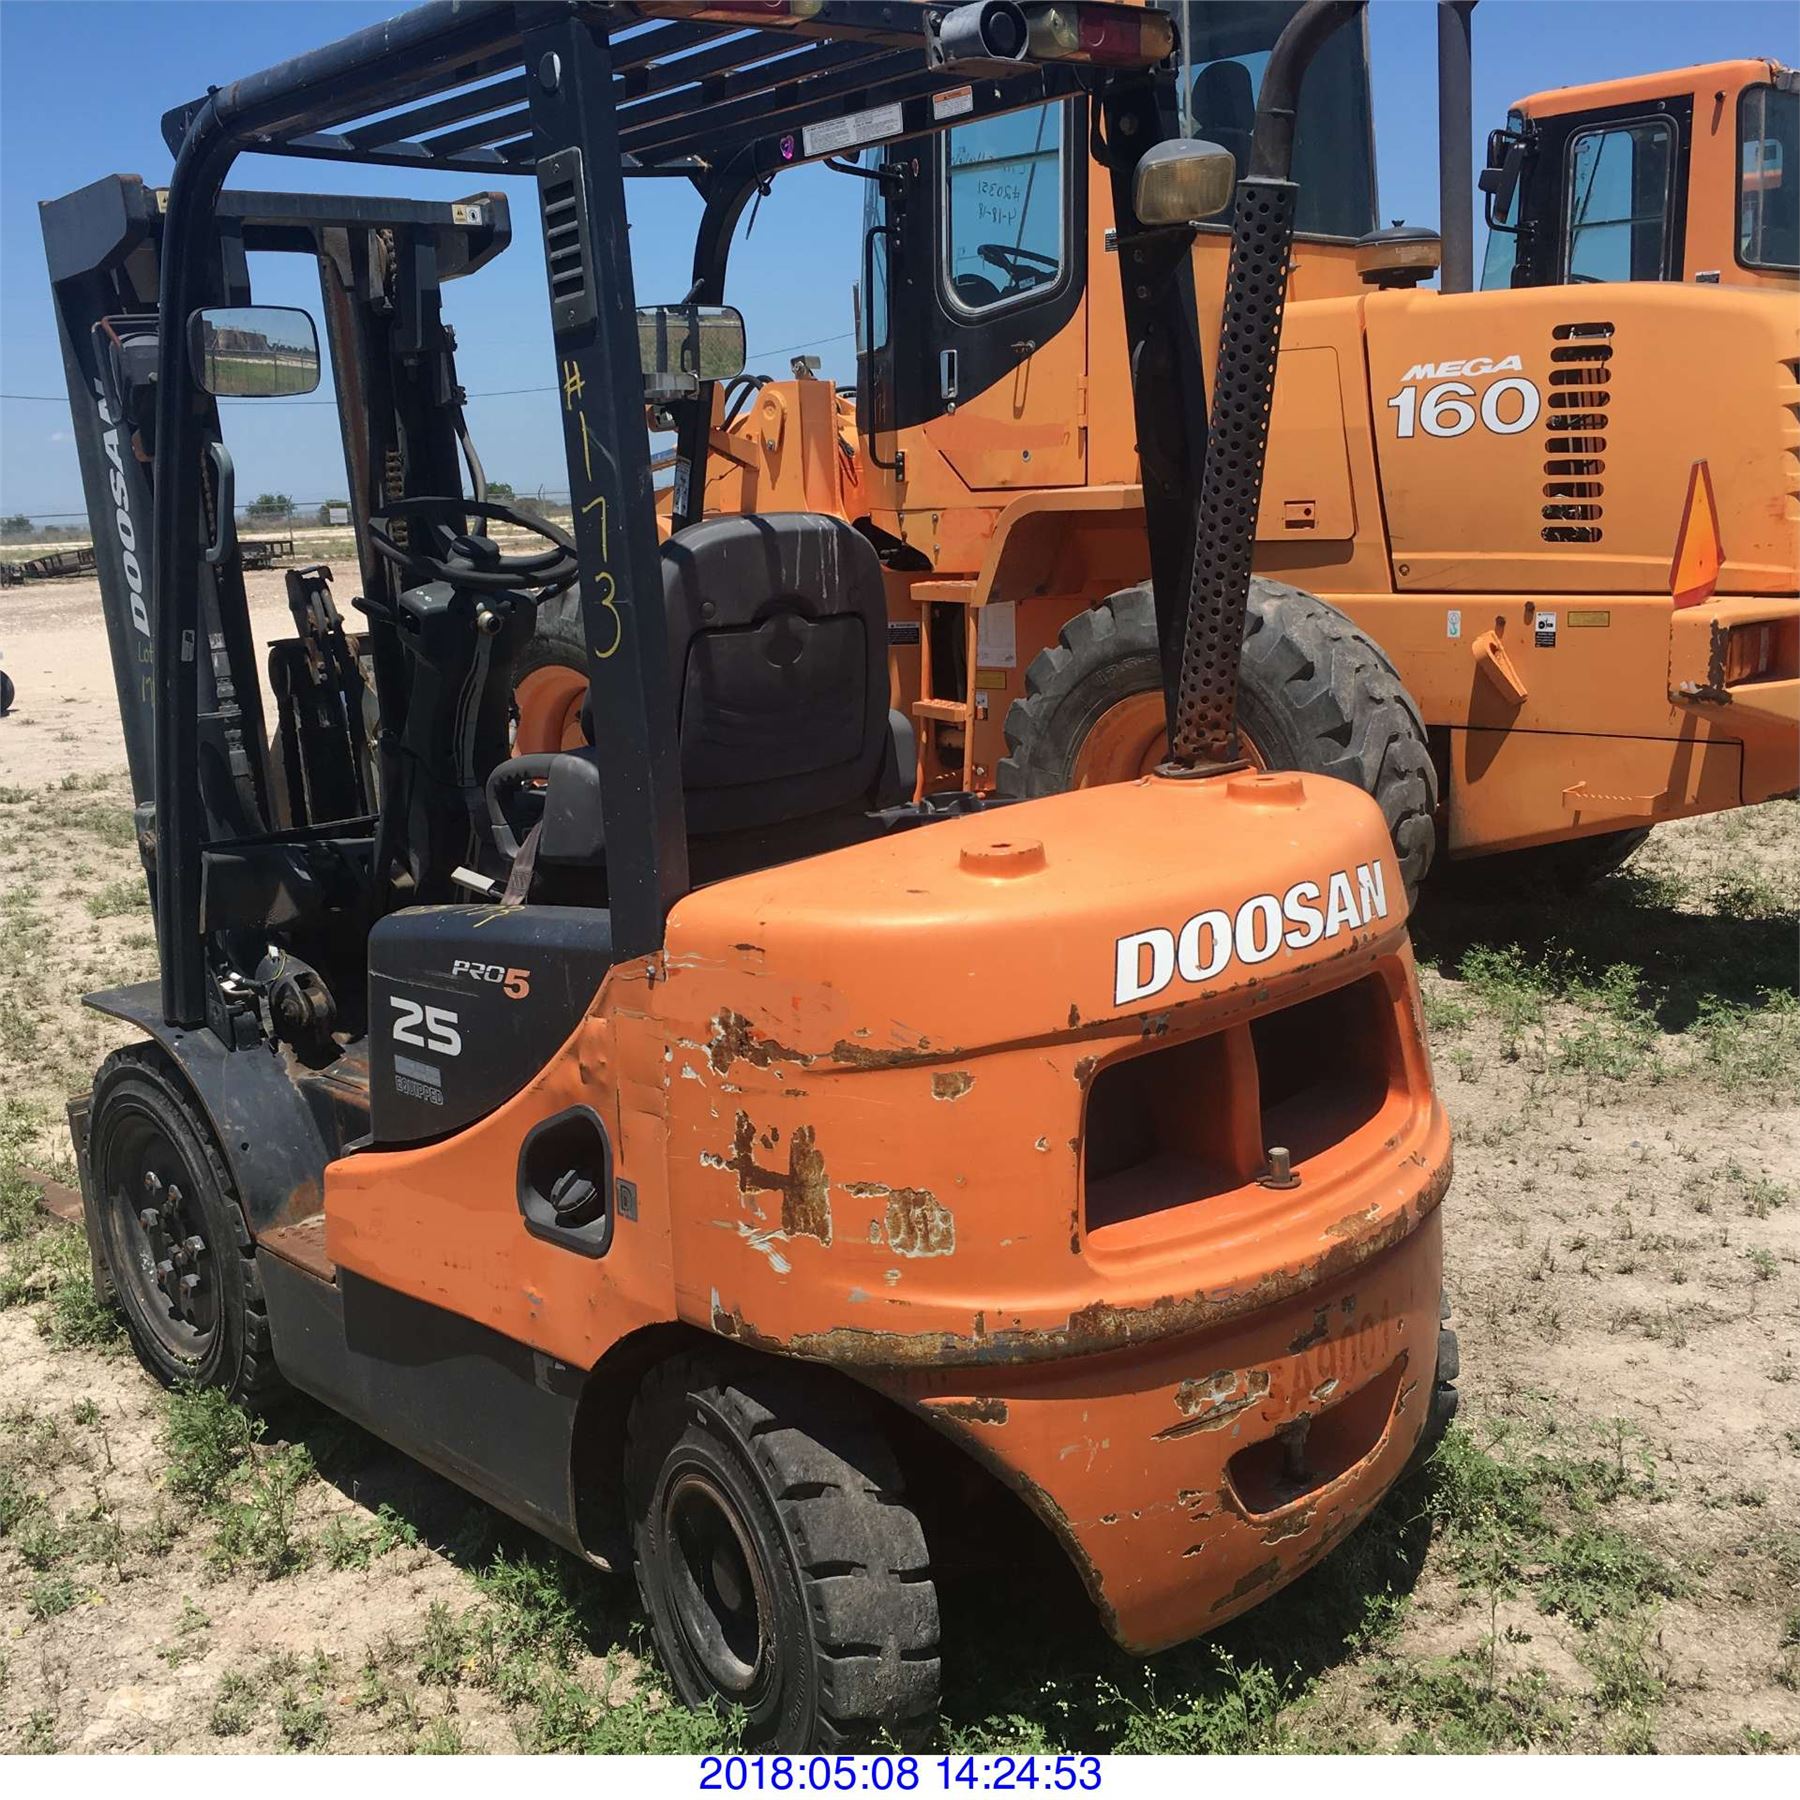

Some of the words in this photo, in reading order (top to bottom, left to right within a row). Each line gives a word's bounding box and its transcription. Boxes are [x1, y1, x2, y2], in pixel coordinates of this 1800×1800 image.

[1401, 355, 1524, 382] MEGA
[1387, 376, 1542, 439] 160
[93, 376, 150, 637] DOOSAN
[1114, 859, 1388, 1007] DOOSAN
[390, 995, 462, 1057] 25
